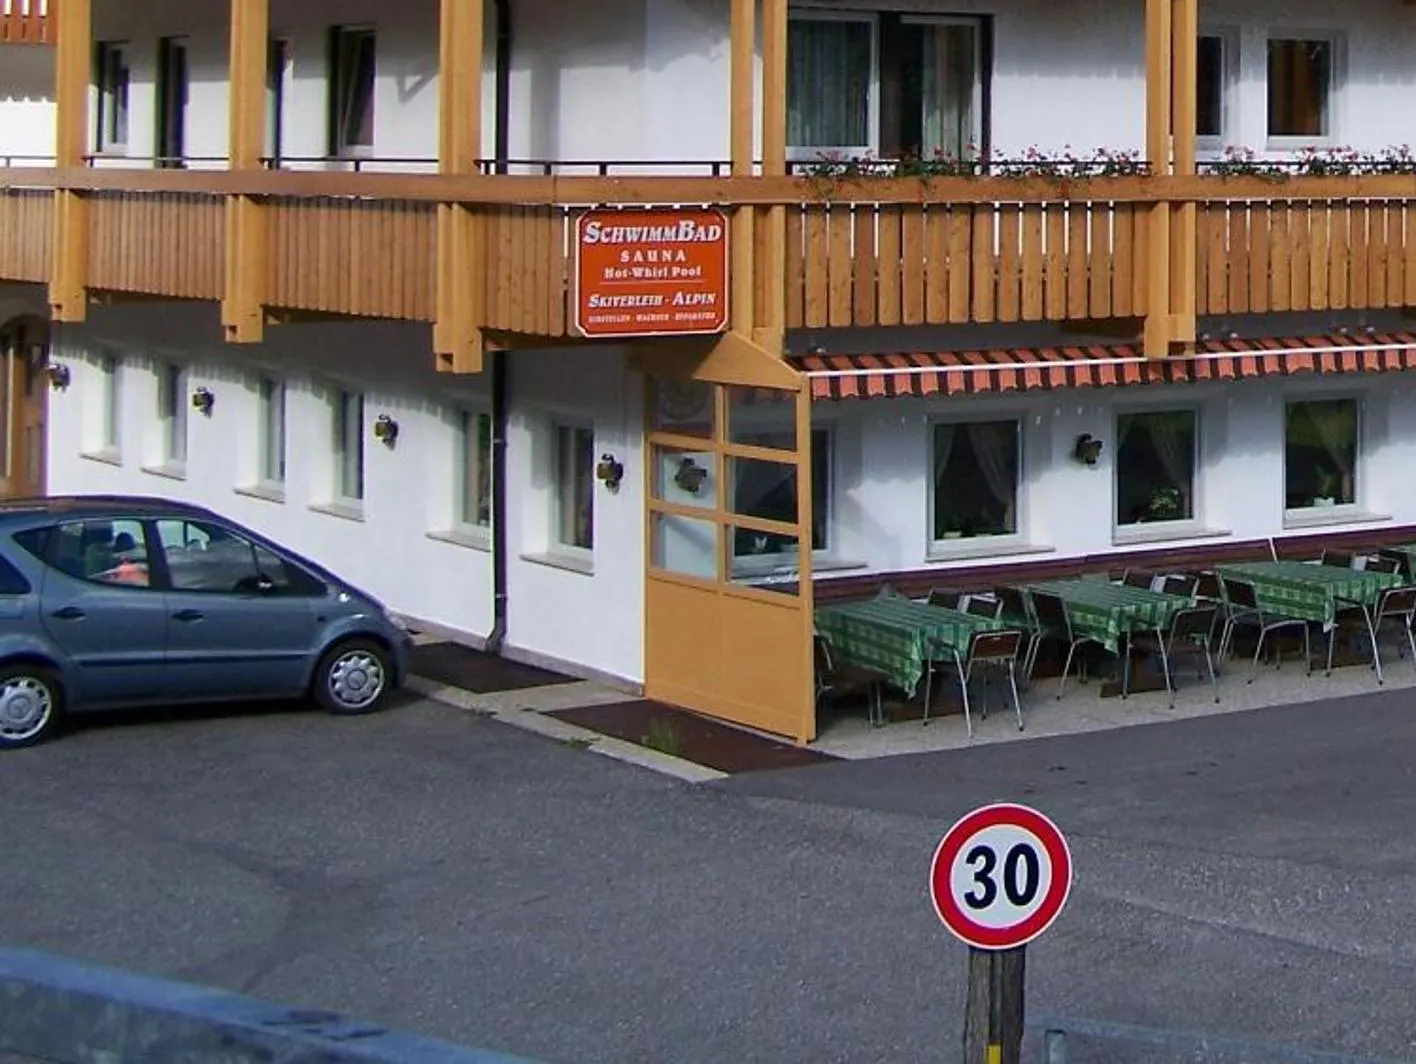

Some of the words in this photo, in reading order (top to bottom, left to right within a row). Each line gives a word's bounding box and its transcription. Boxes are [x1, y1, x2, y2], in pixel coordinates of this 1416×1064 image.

[620, 250, 686, 262] SAUNA
[672, 266, 701, 277] Pool
[964, 842, 1040, 910] 30
